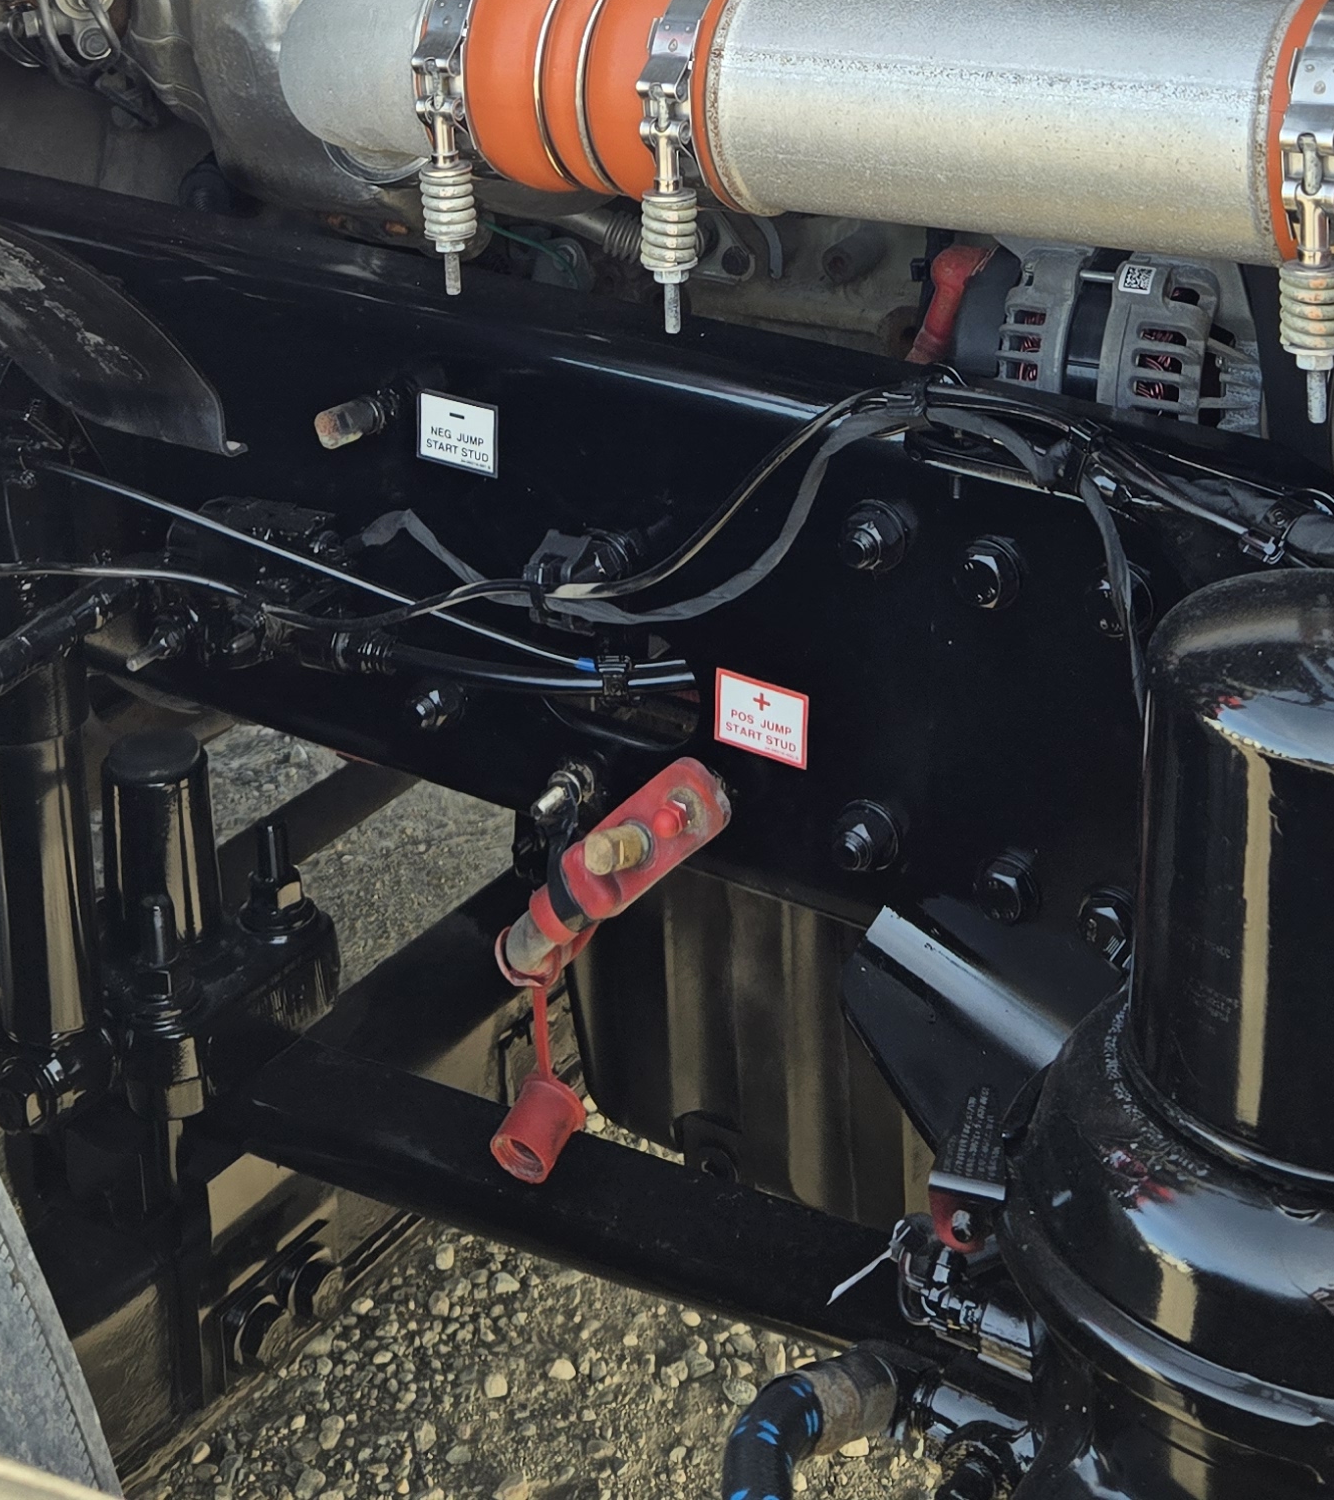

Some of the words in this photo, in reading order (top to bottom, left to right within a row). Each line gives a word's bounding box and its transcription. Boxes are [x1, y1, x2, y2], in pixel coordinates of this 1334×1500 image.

[430, 425, 452, 440] NEG
[456, 432, 484, 447] JUMP
[426, 438, 458, 455] START
[461, 447, 489, 463] STUD
[730, 708, 755, 725] POS
[760, 719, 792, 736] JUMP
[725, 721, 763, 741] START
[765, 735, 797, 753] STUD
